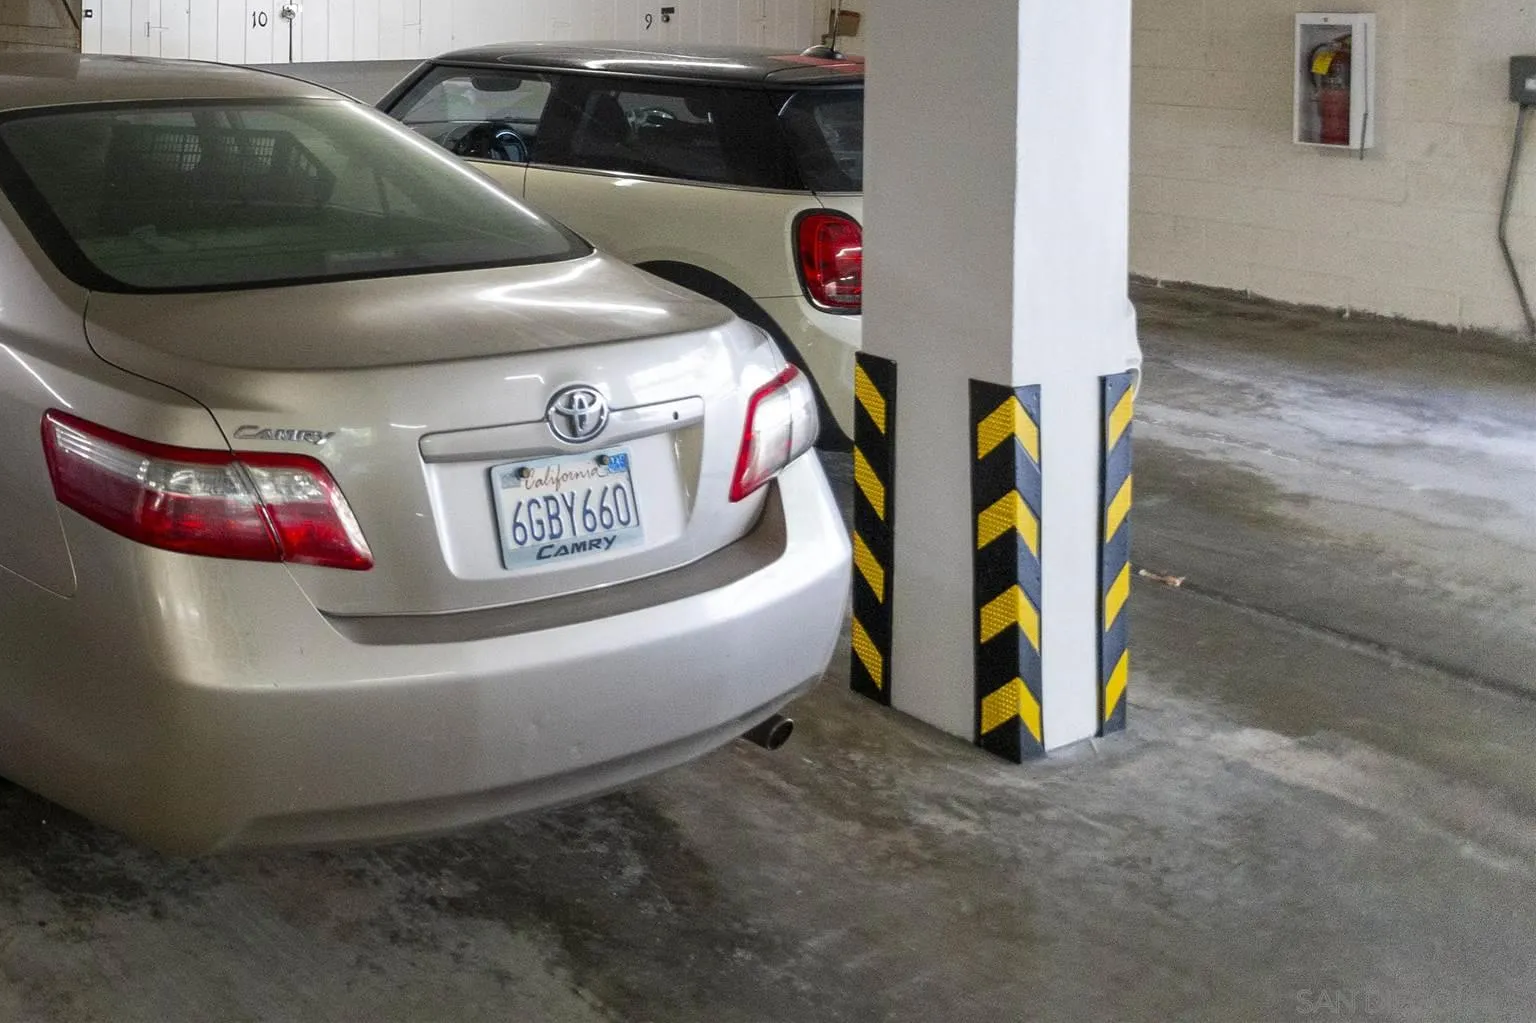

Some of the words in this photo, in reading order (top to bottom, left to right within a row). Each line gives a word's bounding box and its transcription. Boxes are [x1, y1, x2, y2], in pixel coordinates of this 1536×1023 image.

[252, 11, 268, 29] 10
[645, 13, 653, 30] 9
[233, 425, 337, 445] CAMRY
[524, 464, 608, 491] California
[512, 484, 631, 546] 6GBY660
[536, 535, 617, 560] CAMRY
